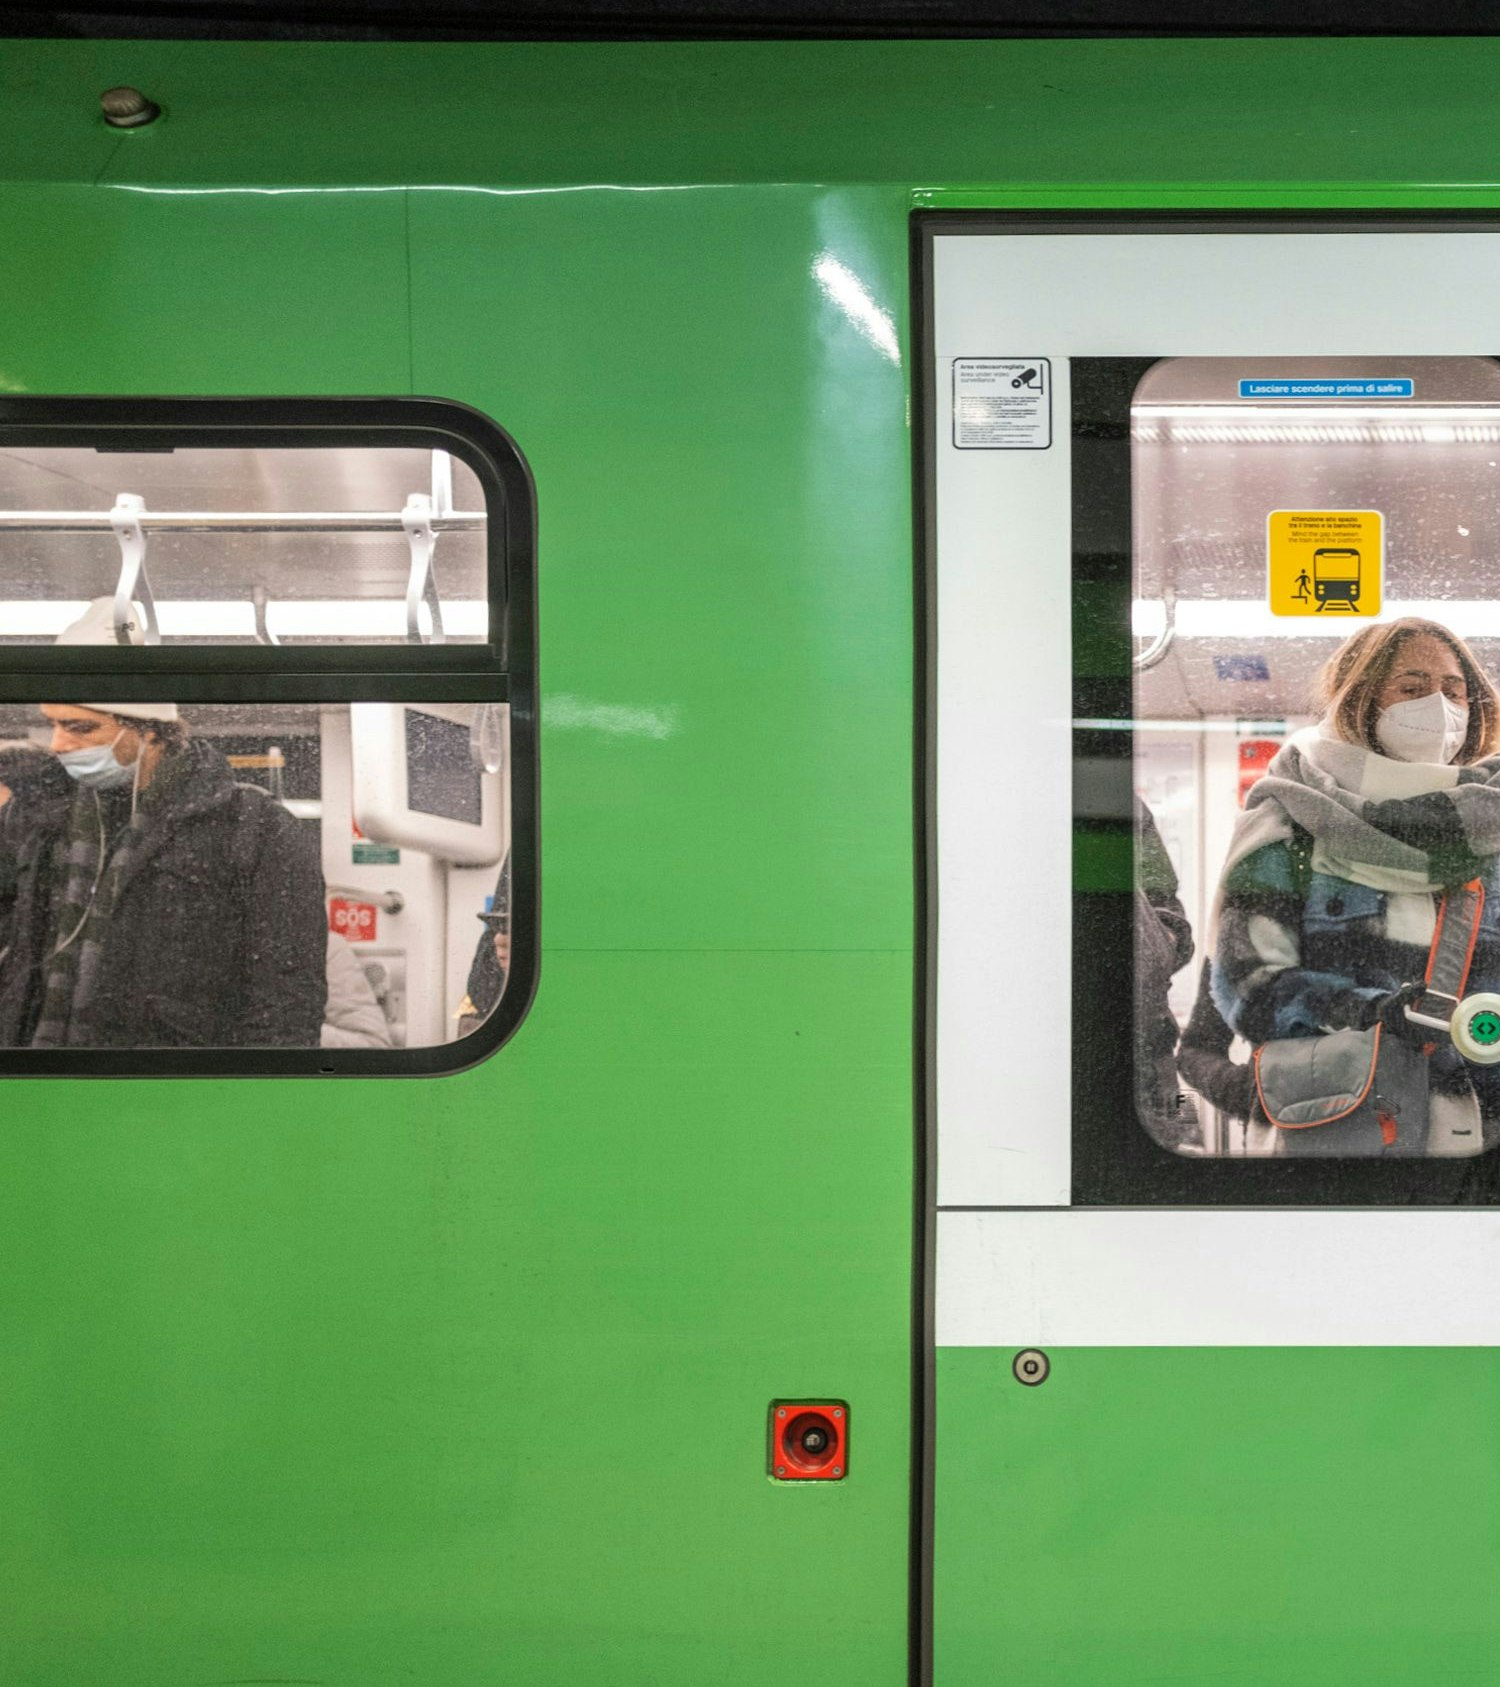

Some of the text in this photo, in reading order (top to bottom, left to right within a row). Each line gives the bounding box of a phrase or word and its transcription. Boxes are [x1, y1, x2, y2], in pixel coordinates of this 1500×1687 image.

[1250, 384, 1403, 394] Lasciare scendere prima di salire
[335, 908, 371, 927] SOS
